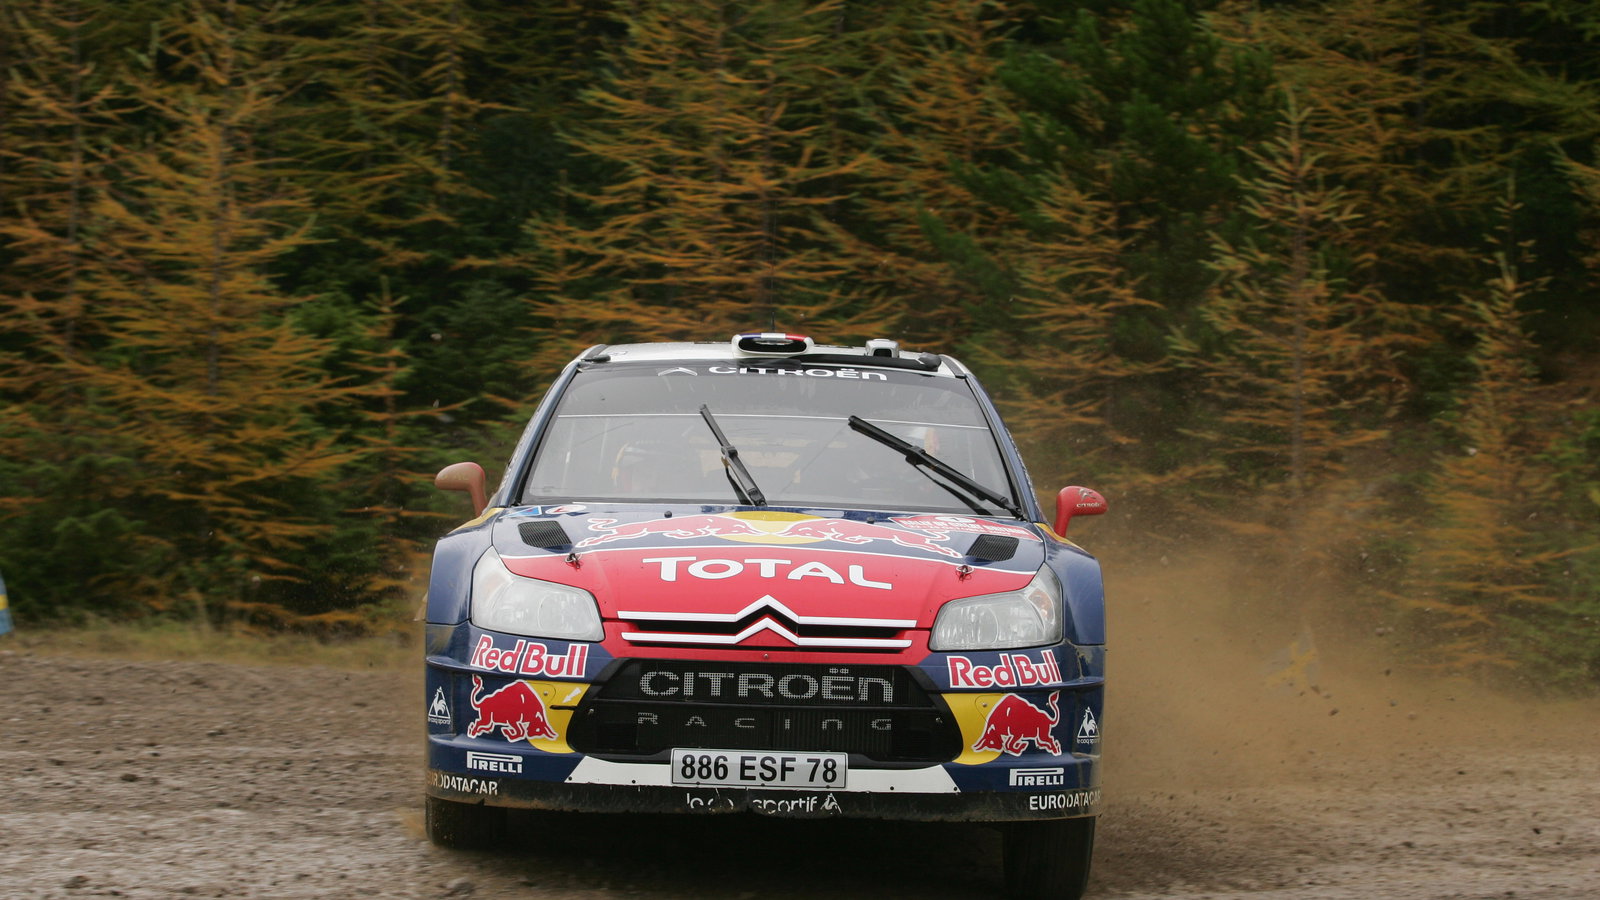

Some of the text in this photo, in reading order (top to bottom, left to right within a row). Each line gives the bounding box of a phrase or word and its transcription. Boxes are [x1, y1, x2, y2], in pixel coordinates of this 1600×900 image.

[642, 556, 893, 590] TOTAL
[470, 634, 590, 678] Red Bull
[946, 649, 1063, 689] Red Bull
[466, 751, 523, 774] PIRELLI
[681, 754, 838, 784] 886 ESF 78
[1009, 767, 1064, 787] PIRELLI
